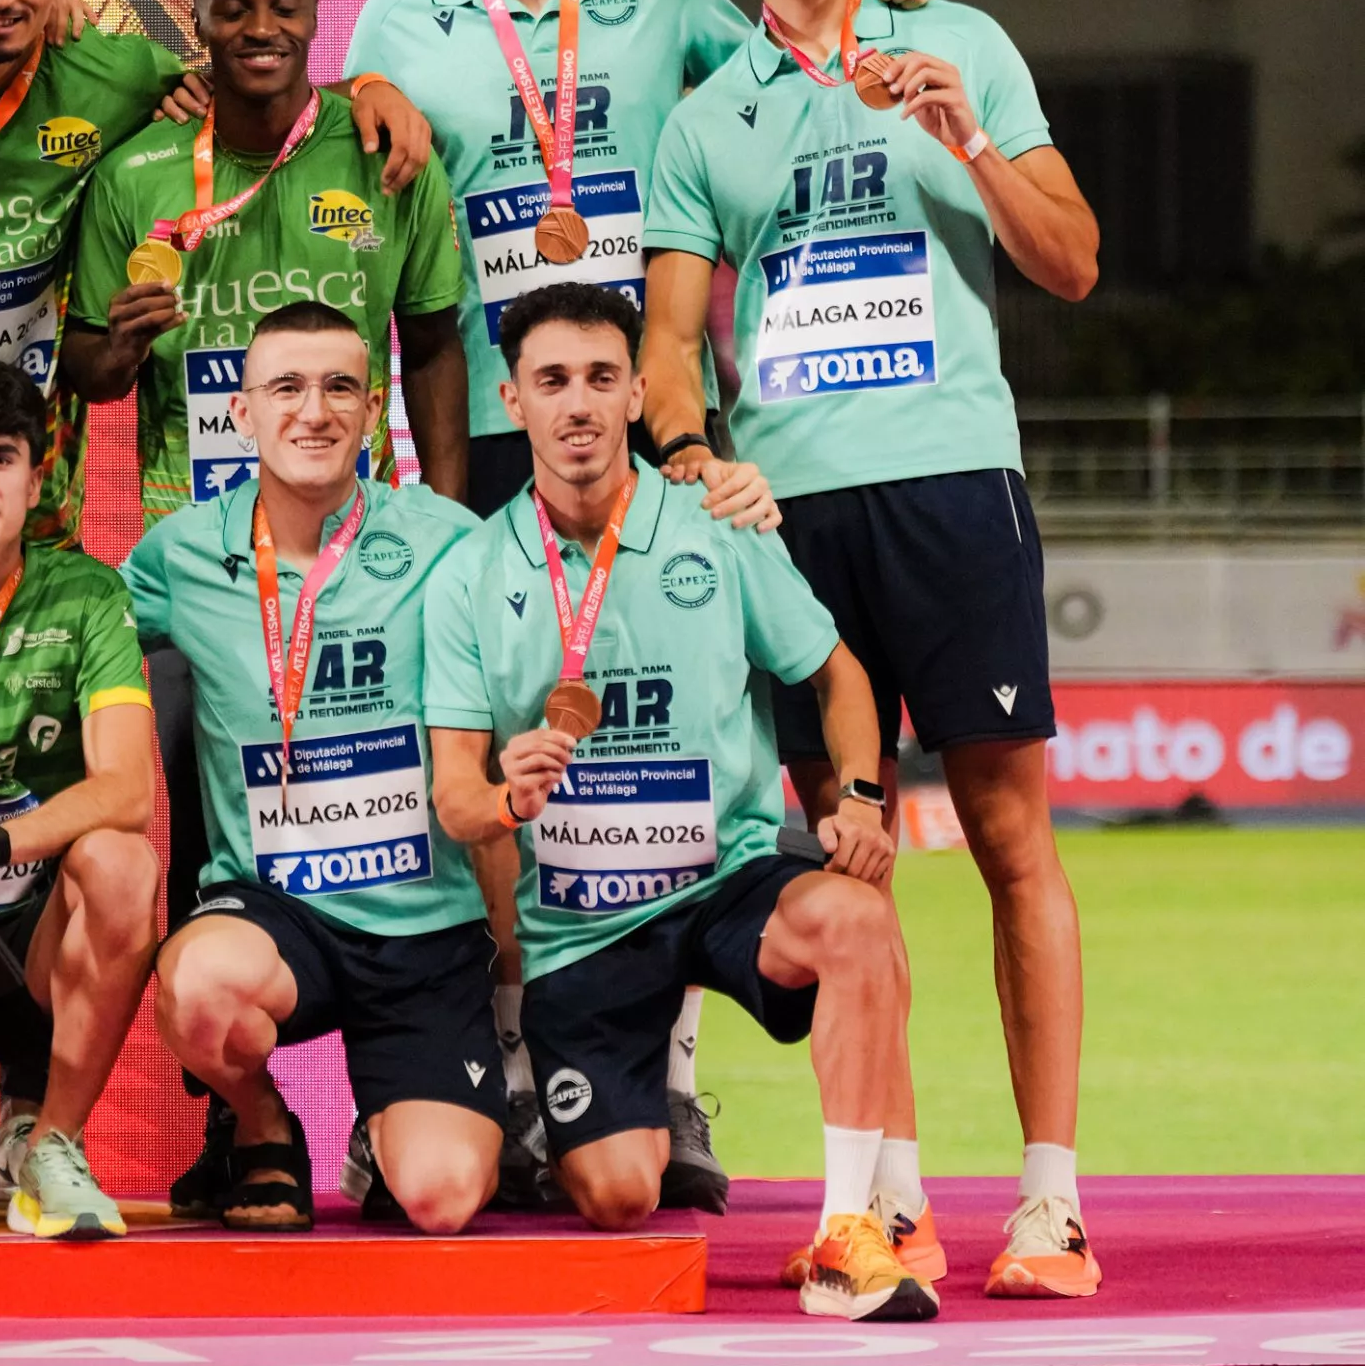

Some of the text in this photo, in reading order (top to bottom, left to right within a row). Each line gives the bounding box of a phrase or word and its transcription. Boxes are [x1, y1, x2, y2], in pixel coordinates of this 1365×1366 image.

[558, 49, 575, 123] ATLETISMO
[38, 124, 102, 152] intec
[493, 157, 527, 170] ALTO
[577, 181, 626, 196] Provincial
[310, 195, 374, 224] intec
[519, 208, 534, 220] de
[203, 221, 241, 239] OITI
[782, 211, 896, 244] ALTO RENDIMIENTO
[589, 236, 638, 259] 2026
[801, 241, 913, 265] Diputación Provincial
[801, 260, 855, 277] de Málaga
[176, 268, 367, 319] Huesca
[765, 297, 923, 334] MÁLAGA 2026
[265, 597, 283, 672] ATLETISMO
[293, 597, 312, 675] ATLETISMO
[318, 629, 353, 640] ANGEL
[357, 626, 385, 636] RAMA
[602, 667, 637, 678] ANGEL
[641, 664, 672, 675] RAMA
[310, 699, 394, 719] RENDIMIENTO
[599, 679, 674, 729] AR
[294, 735, 406, 761] Diputación Provincial
[590, 742, 681, 758] RENDIMIENTO
[1239, 702, 1351, 782] de
[297, 757, 353, 774] de Málaga
[578, 768, 696, 784] Diputación Provincial
[578, 784, 638, 797] de Málaga
[364, 791, 418, 817] 2026
[540, 821, 705, 845] MÁLAGA 2026
